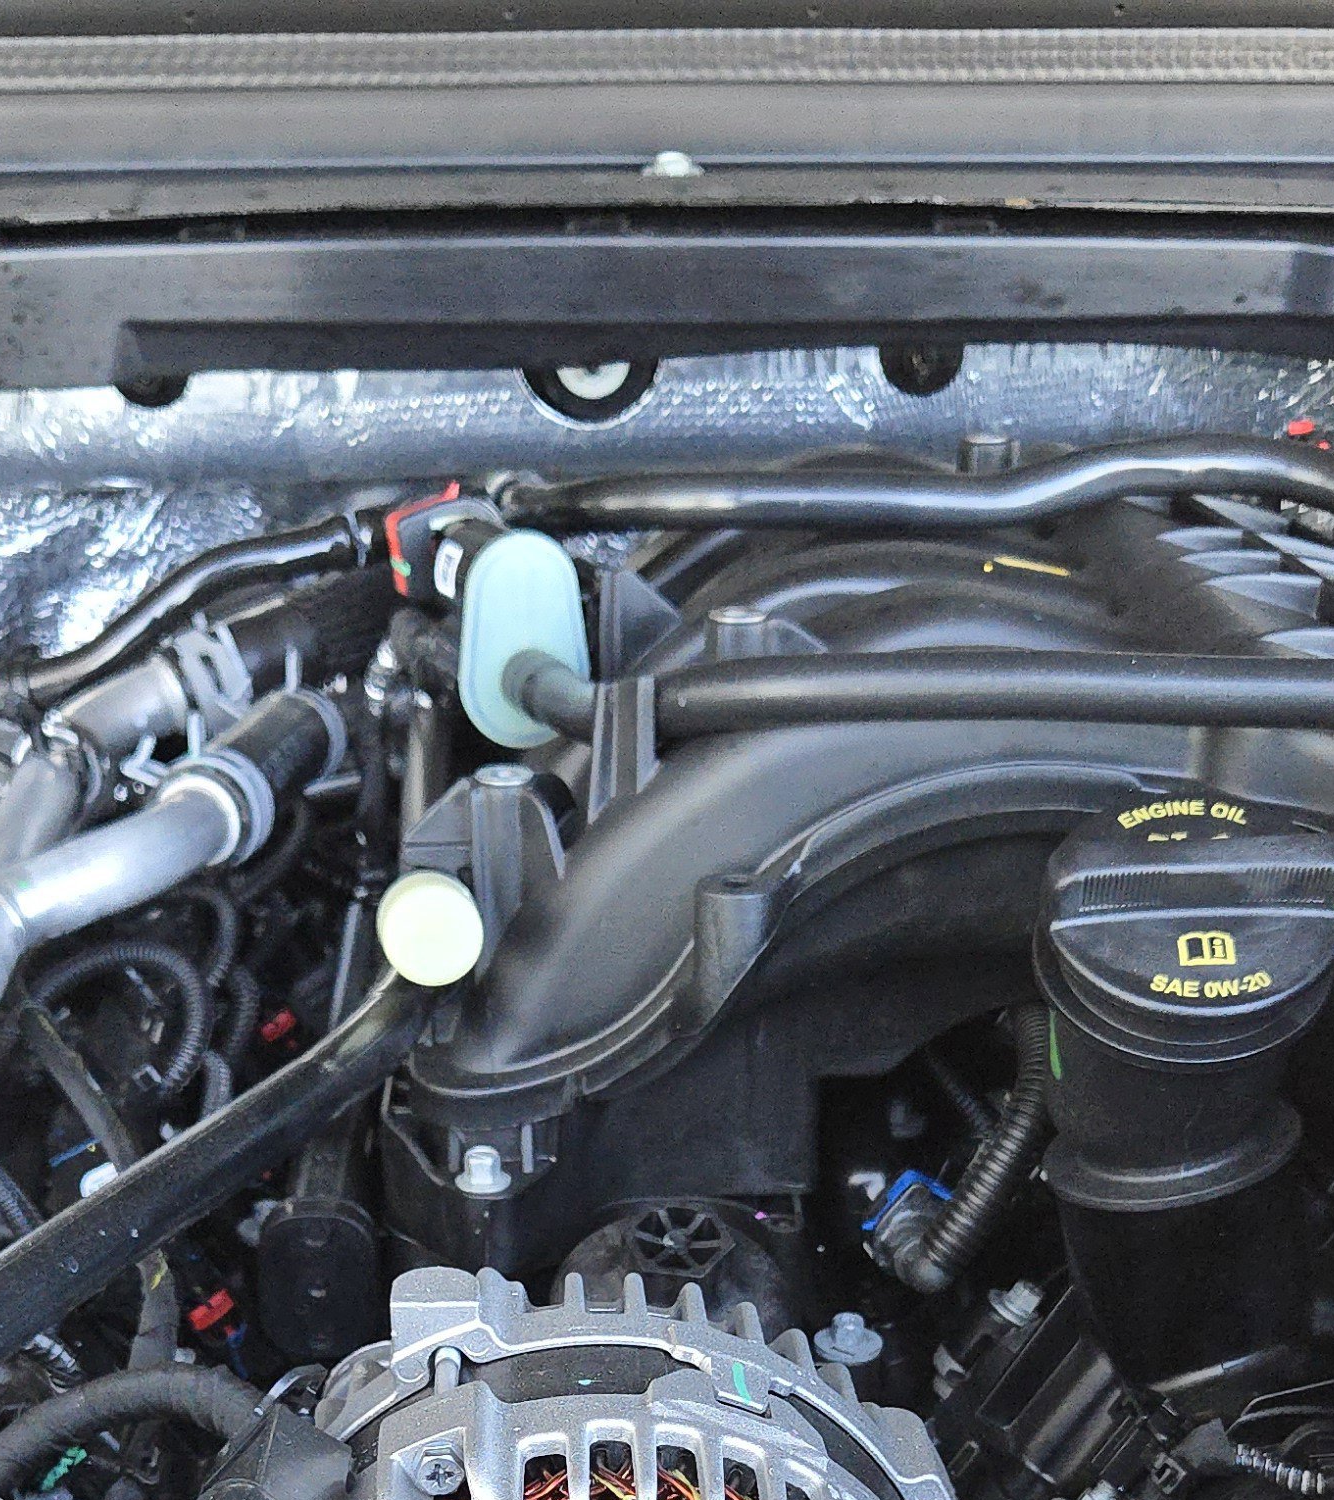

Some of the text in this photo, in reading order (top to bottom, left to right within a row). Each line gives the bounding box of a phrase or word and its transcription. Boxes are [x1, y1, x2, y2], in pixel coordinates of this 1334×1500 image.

[1117, 799, 1248, 829] ENGINE OIL
[1150, 970, 1273, 998] SAE 0W-20
